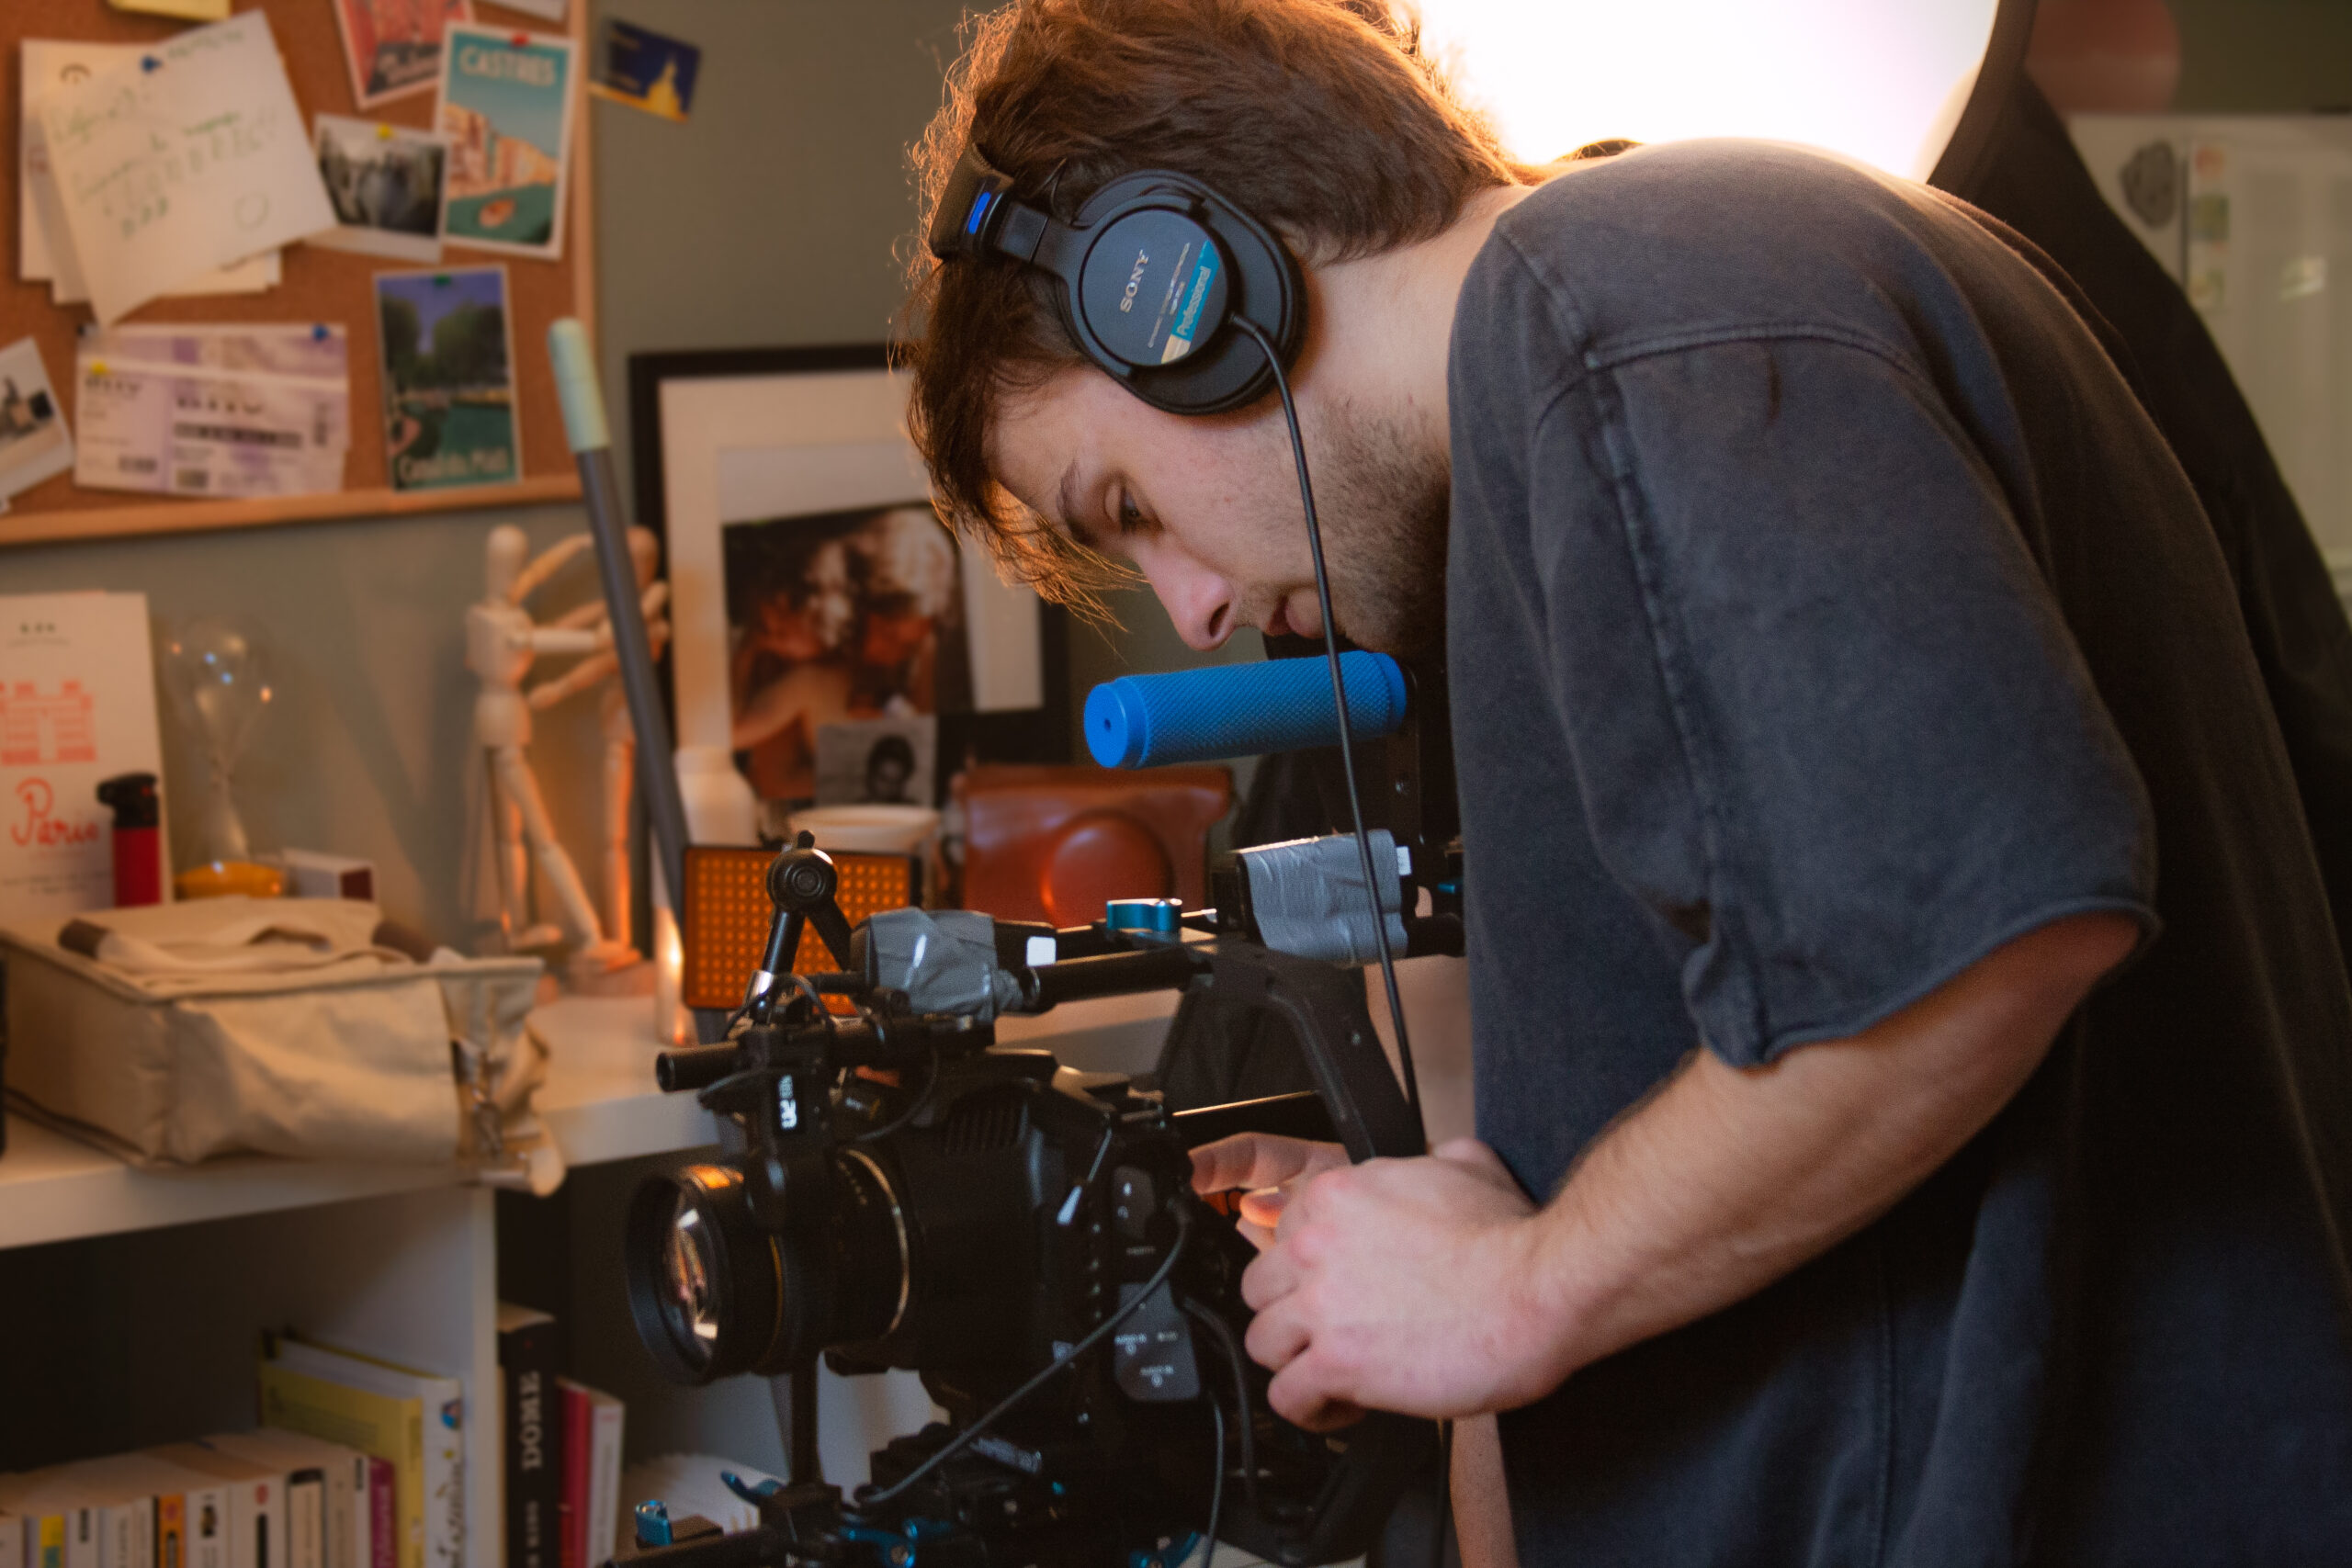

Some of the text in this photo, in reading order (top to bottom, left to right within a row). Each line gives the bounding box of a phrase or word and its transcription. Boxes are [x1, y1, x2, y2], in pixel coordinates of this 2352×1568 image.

[459, 46, 556, 86] CASTRES
[1120, 249, 1148, 312] SONY
[1177, 265, 1211, 336] Professional
[520, 1371, 543, 1470] DOME
